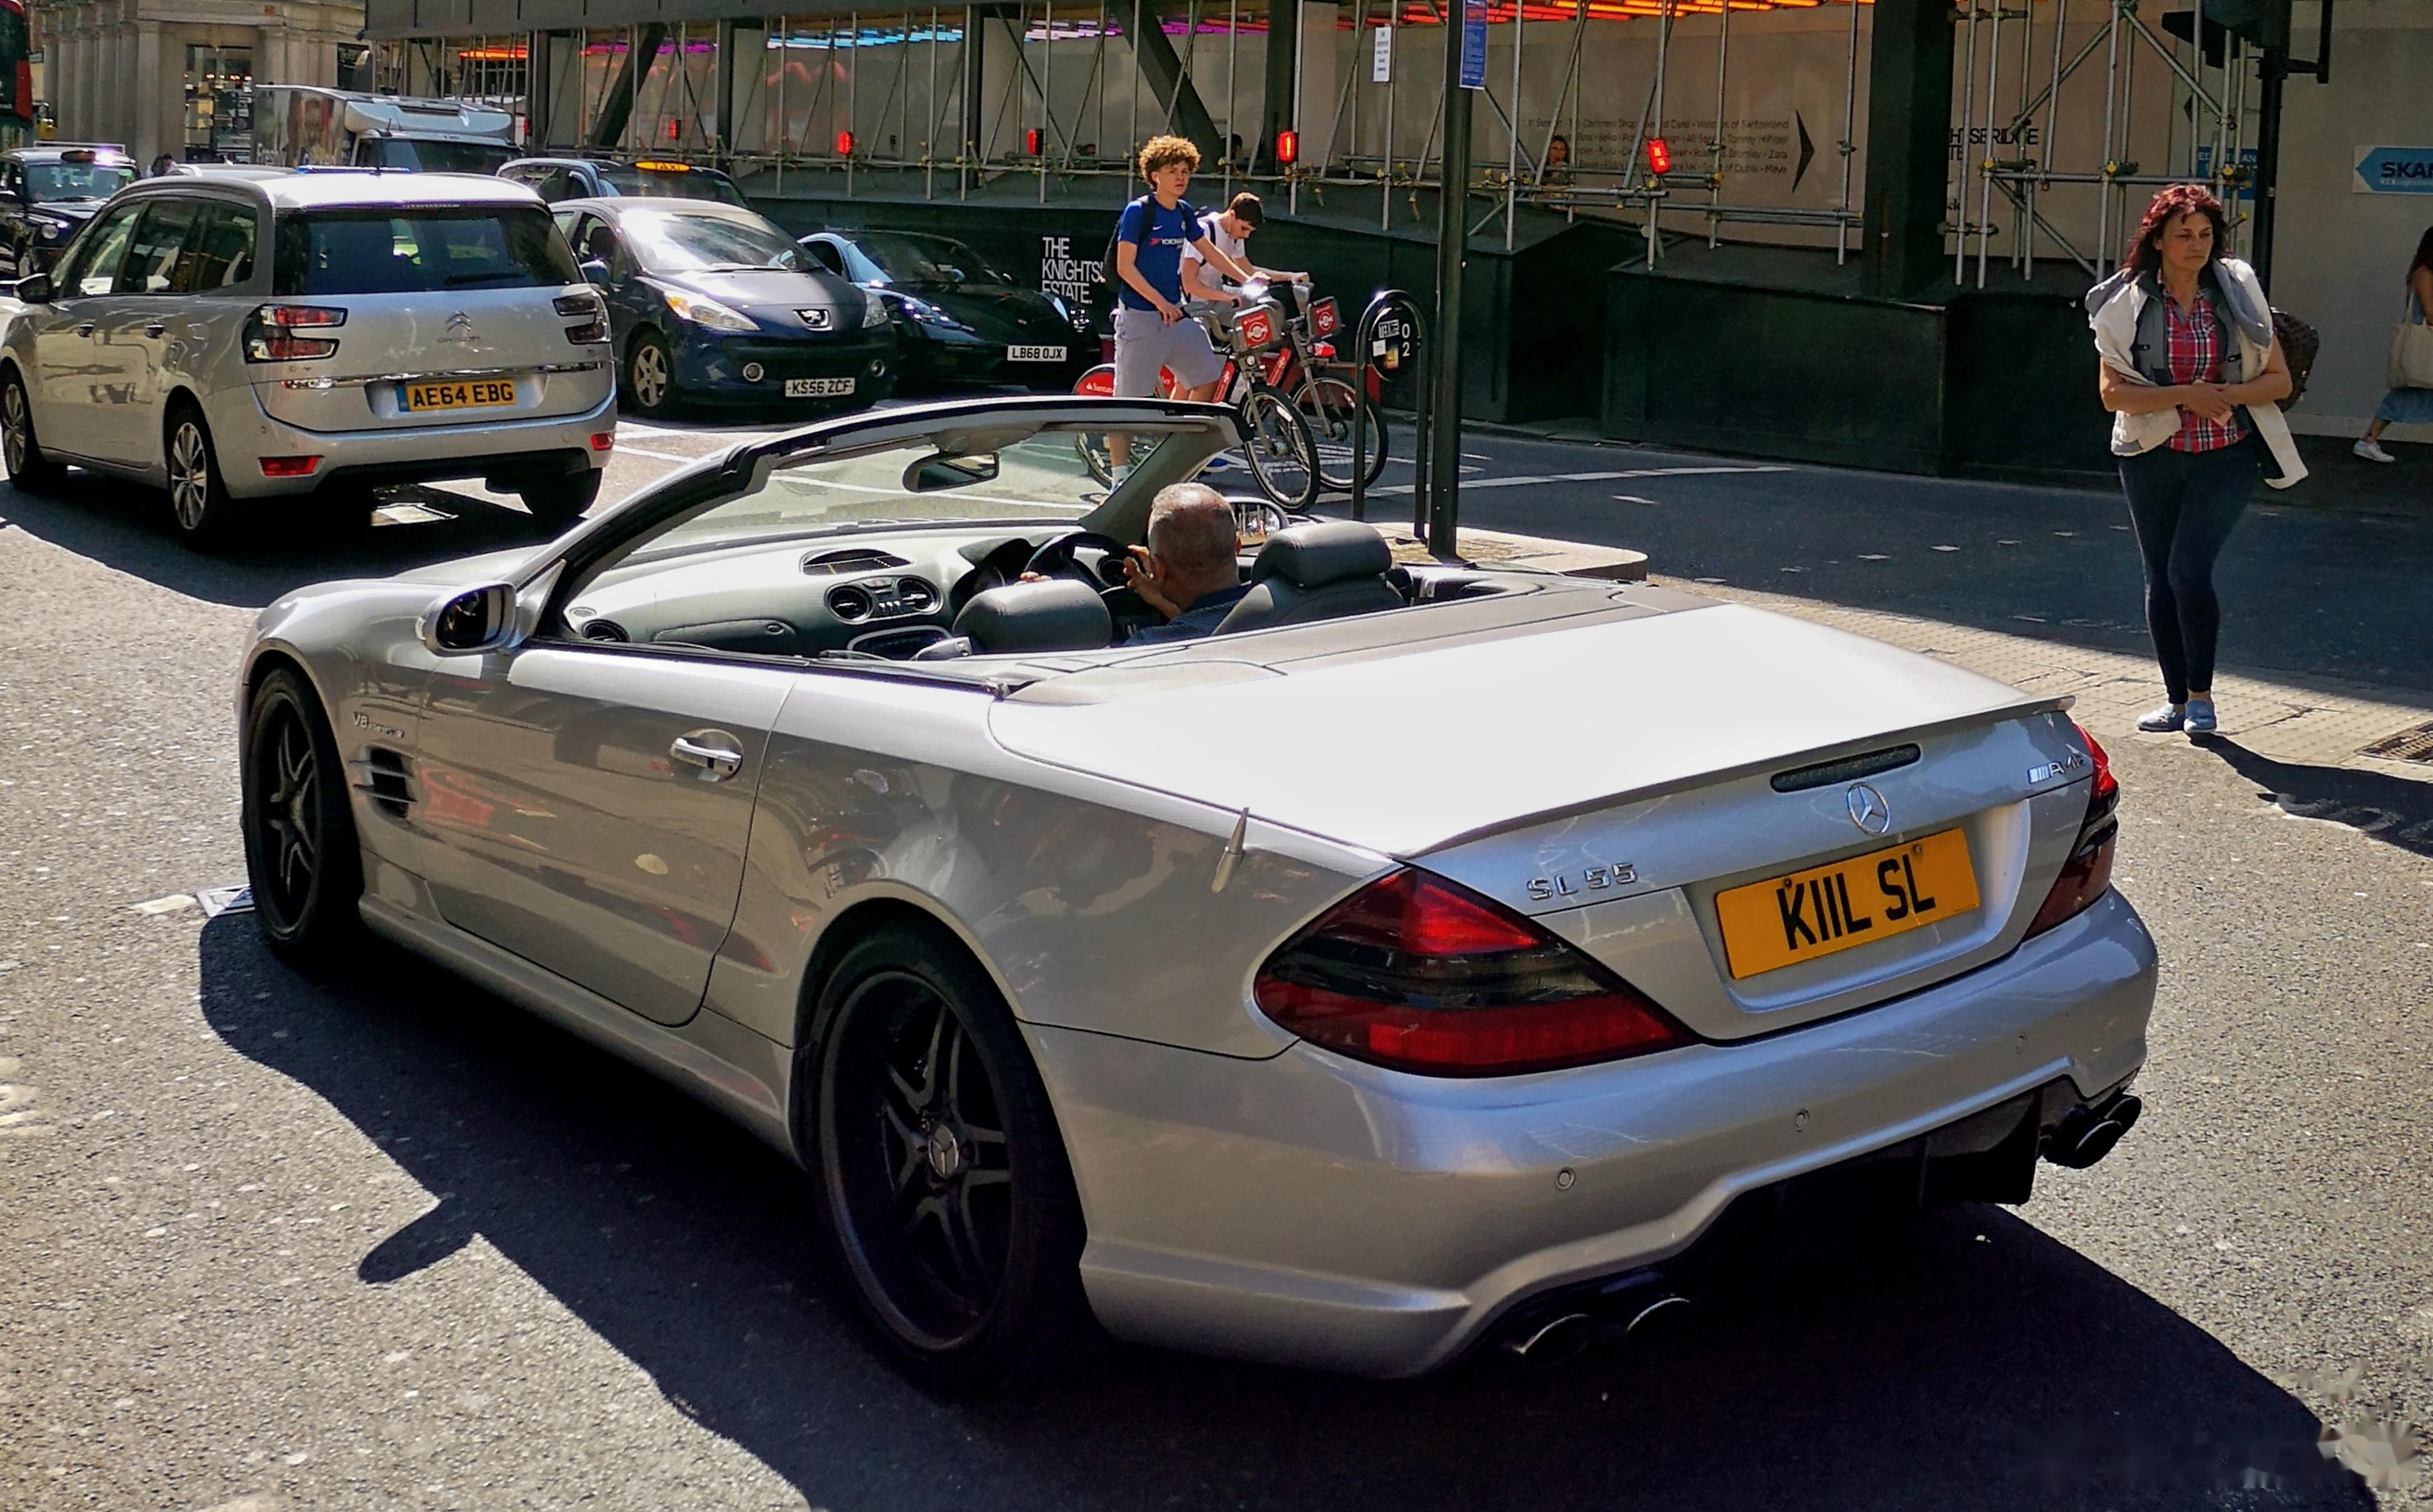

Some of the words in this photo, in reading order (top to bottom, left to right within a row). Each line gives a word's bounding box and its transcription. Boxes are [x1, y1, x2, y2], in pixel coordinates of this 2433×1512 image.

[654, 162, 680, 171] TAXI
[1042, 237, 1070, 259] THE
[1012, 347, 1040, 359] LB68
[1402, 341, 1411, 357] 2
[413, 386, 468, 407] AE64
[472, 383, 513, 402] EBG
[792, 381, 824, 394] KS56
[827, 380, 851, 393] ZCF
[353, 712, 369, 728] V8
[1527, 875, 1579, 900] SL
[1584, 862, 1637, 890] 55
[1877, 854, 1937, 922] SL
